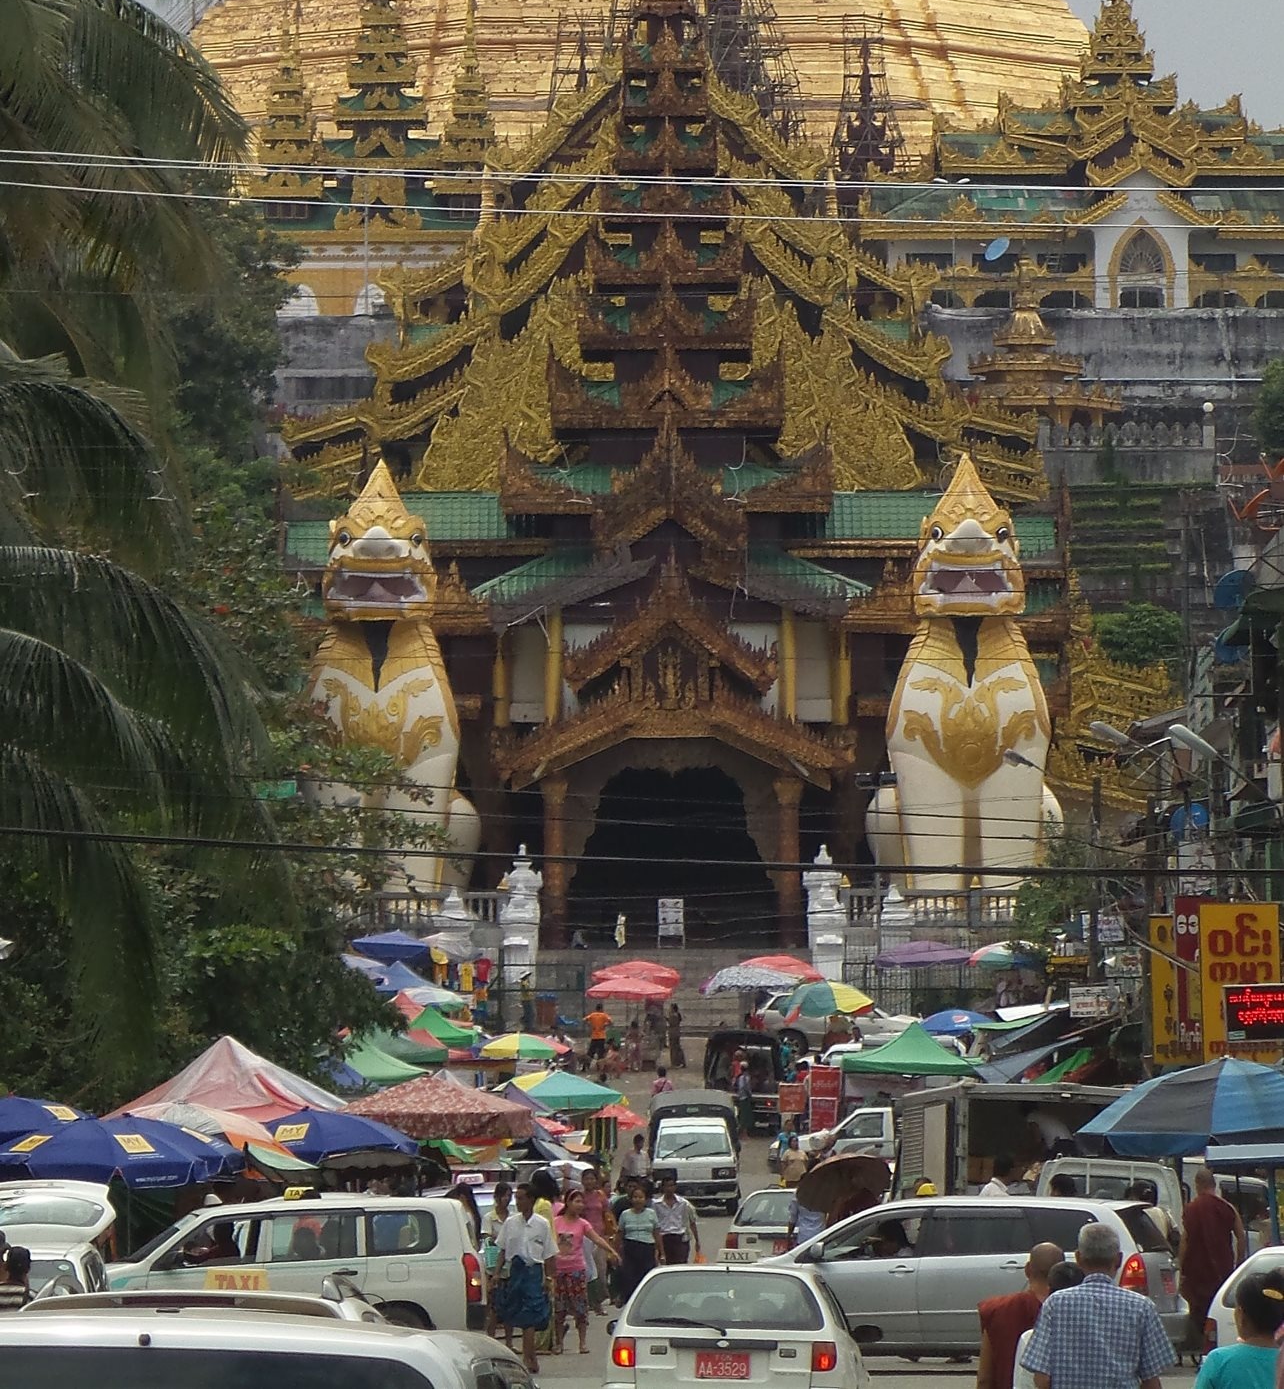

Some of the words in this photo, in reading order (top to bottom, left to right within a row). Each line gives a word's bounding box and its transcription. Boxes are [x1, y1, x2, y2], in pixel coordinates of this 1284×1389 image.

[281, 1126, 304, 1134] MY
[724, 1252, 749, 1260] TAXI
[215, 1274, 259, 1290] TAXI
[699, 1362, 747, 1376] AA-3529
